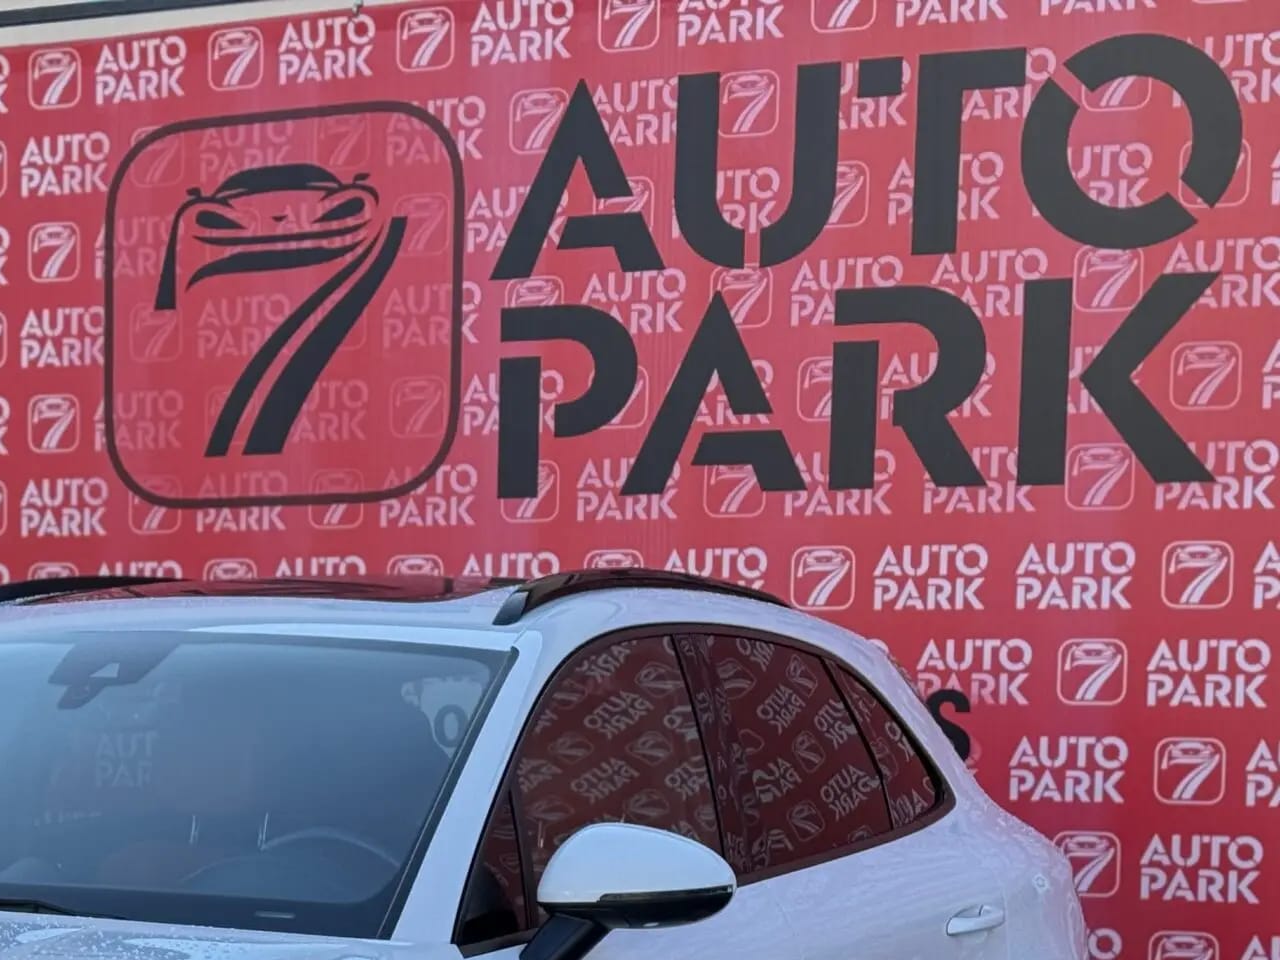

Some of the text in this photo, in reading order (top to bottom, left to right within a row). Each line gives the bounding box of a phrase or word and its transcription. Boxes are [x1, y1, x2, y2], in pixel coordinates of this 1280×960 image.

[470, 0, 574, 33] AUTO
[678, 5, 783, 47] PARK
[278, 13, 376, 54] AUTO
[471, 26, 571, 67] PARK
[95, 35, 187, 74] AUTO
[279, 44, 373, 85] PARK
[95, 65, 184, 106] PARK
[20, 131, 108, 167] AUTO
[491, 33, 1243, 282] AUTO
[21, 162, 108, 198] PARK
[931, 248, 1048, 285] AUTO
[1164, 236, 1280, 273] AUTO
[582, 268, 686, 303] AUTO
[791, 256, 903, 291] AUTO
[20, 305, 105, 338] AUTO
[20, 335, 104, 368] PARK
[497, 272, 1219, 498] PARK
[20, 477, 108, 508] AUTO
[576, 494, 678, 523] PARK
[785, 484, 892, 517] PARK
[924, 485, 1036, 517] PARK
[1156, 476, 1276, 511] PARK
[20, 507, 107, 538] PARK
[379, 497, 475, 528] PARK
[463, 551, 560, 579] AUTO
[665, 547, 767, 577] AUTO
[874, 544, 988, 576] AUTO
[1017, 542, 1135, 574] AUTO
[874, 578, 984, 610] PARK
[1017, 576, 1131, 609] PARK
[917, 639, 1032, 671] AUTO
[1147, 639, 1270, 672] AUTO
[1148, 674, 1266, 707] PARK
[1010, 736, 1128, 768] AUTO
[1010, 770, 1123, 802] PARK
[1141, 835, 1263, 868] AUTO
[1141, 868, 1258, 903] PARK
